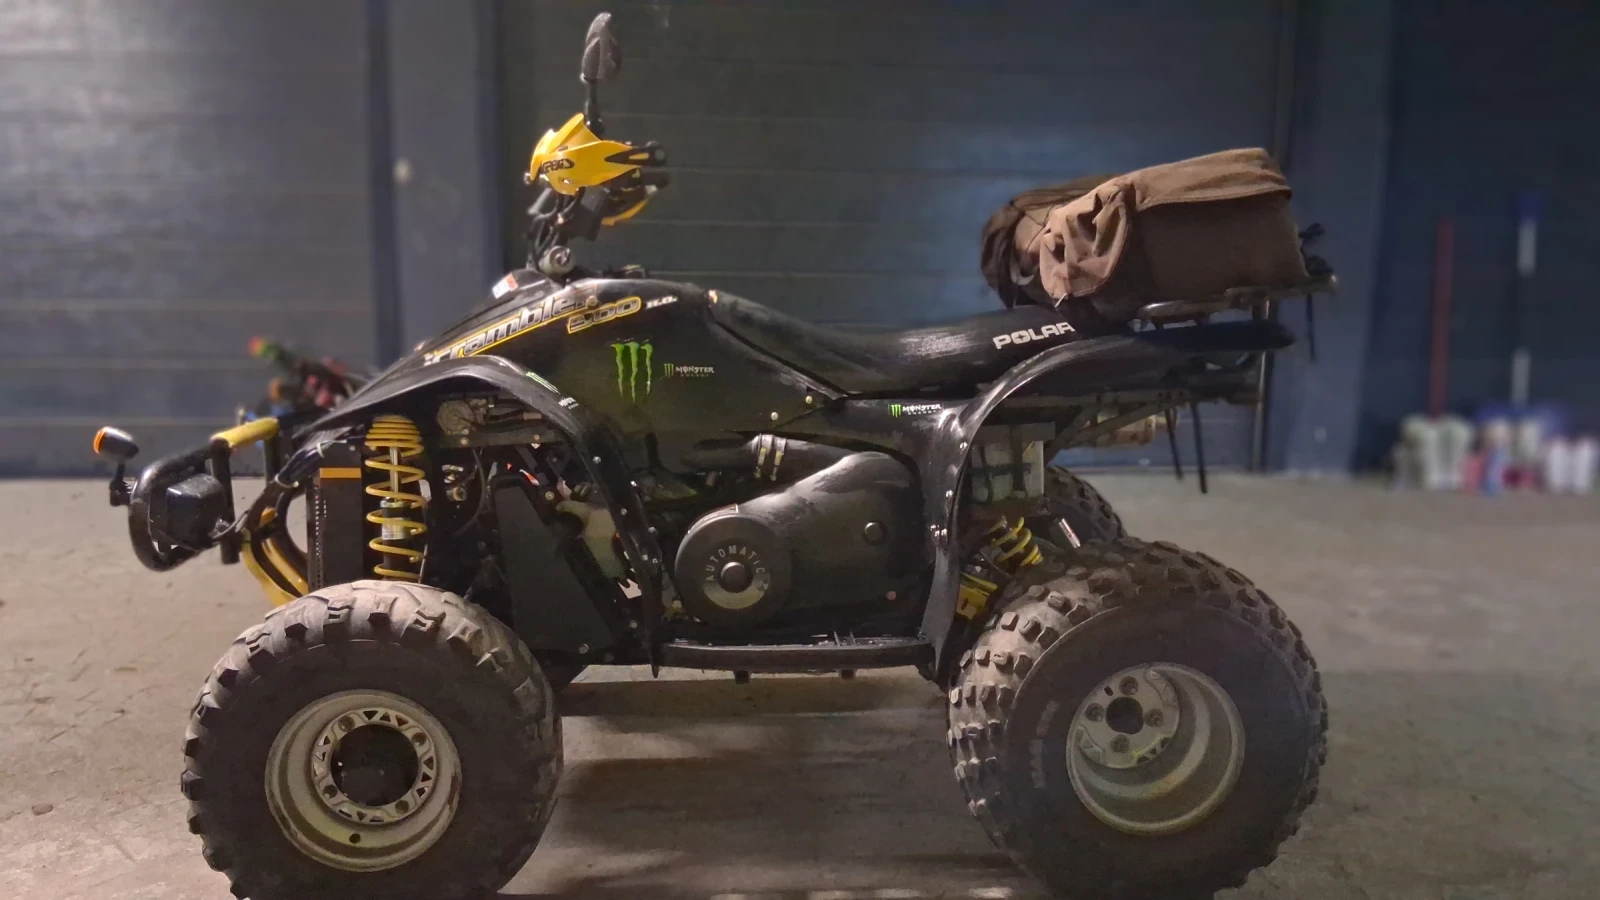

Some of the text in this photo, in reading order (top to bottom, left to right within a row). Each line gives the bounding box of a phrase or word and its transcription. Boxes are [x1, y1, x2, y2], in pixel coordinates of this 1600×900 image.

[567, 297, 641, 334] 500
[992, 321, 1076, 350] POLAR
[902, 403, 942, 412] MONSTER
[705, 544, 766, 582] AUTOMATIC
